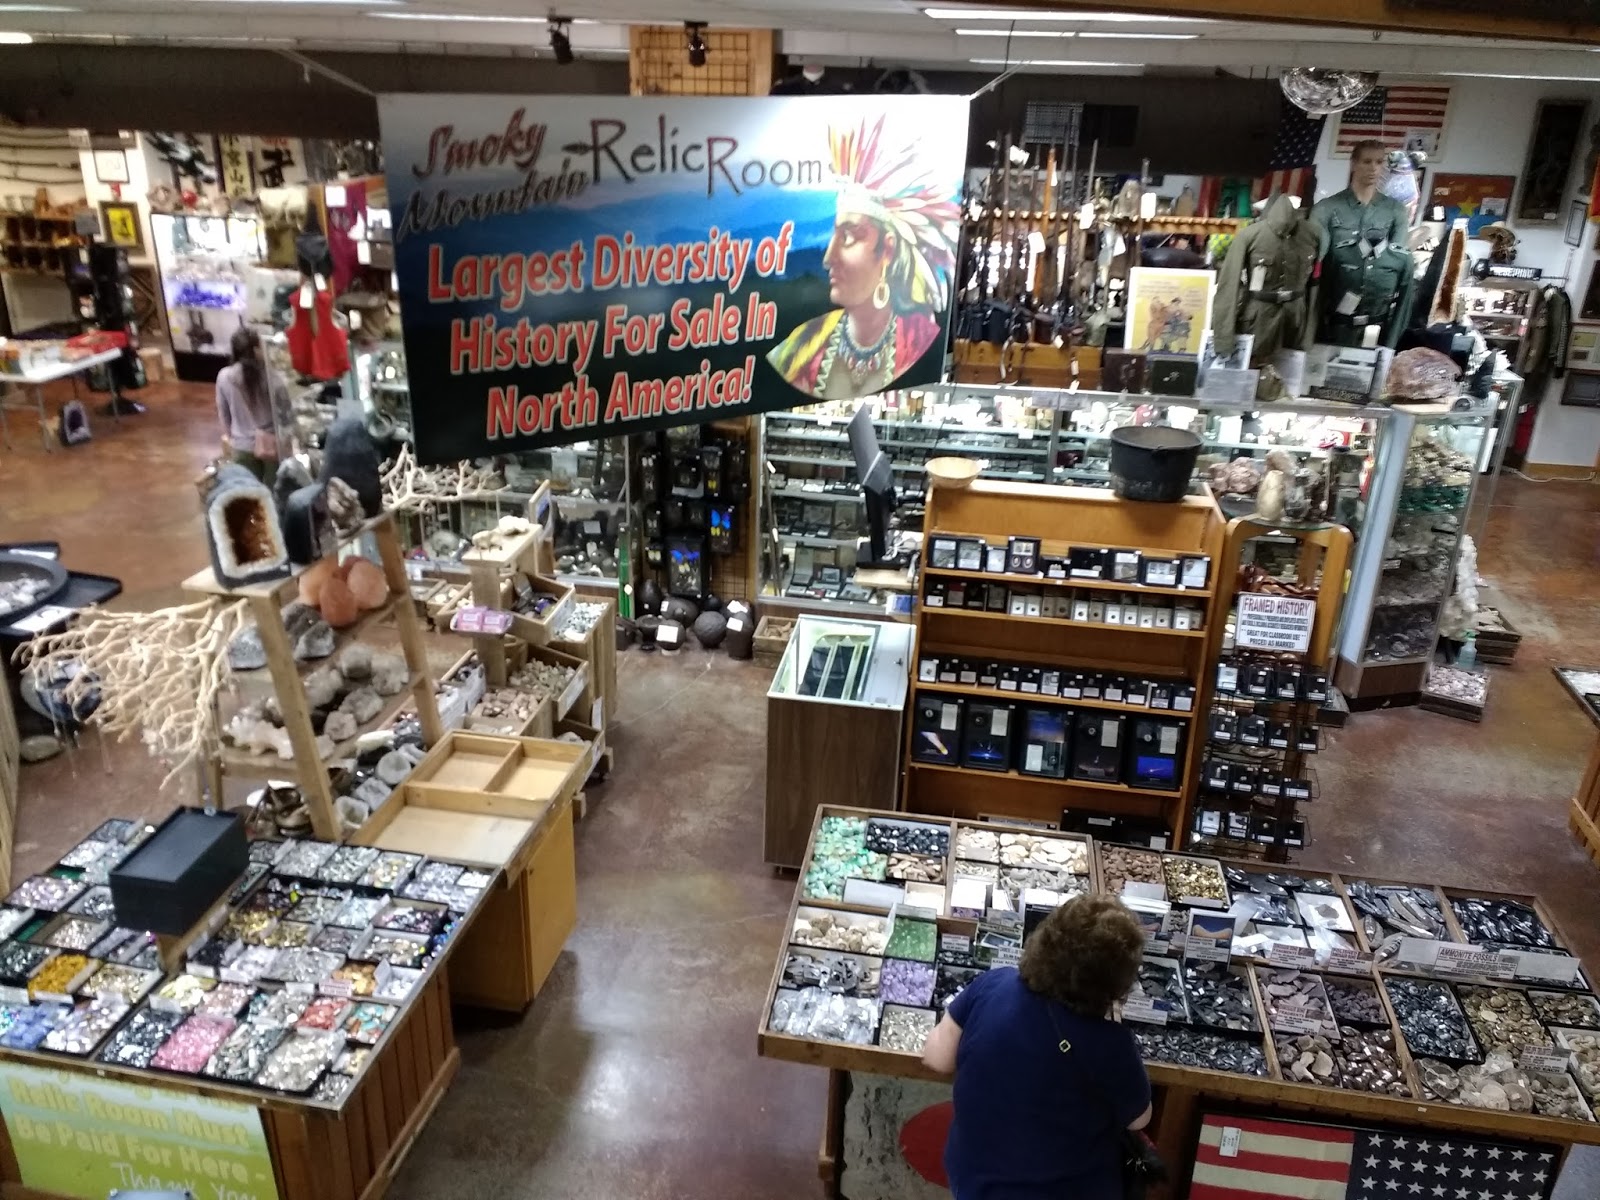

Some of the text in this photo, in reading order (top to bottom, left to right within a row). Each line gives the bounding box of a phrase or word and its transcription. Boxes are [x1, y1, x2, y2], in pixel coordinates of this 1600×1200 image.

[411, 106, 548, 180] Smoky
[396, 156, 590, 241] Mountain
[428, 220, 795, 312] Largest Diversity of
[451, 291, 777, 376] History For Sale In
[486, 355, 756, 440] North America!
[1244, 598, 1310, 616] FRAMED HISTORY
[1440, 948, 1499, 962] AMMONITE FOSSILS
[82, 1089, 169, 1130] Room
[172, 1106, 250, 1149] Must
[125, 1134, 172, 1169] For
[178, 1146, 249, 1184] Here
